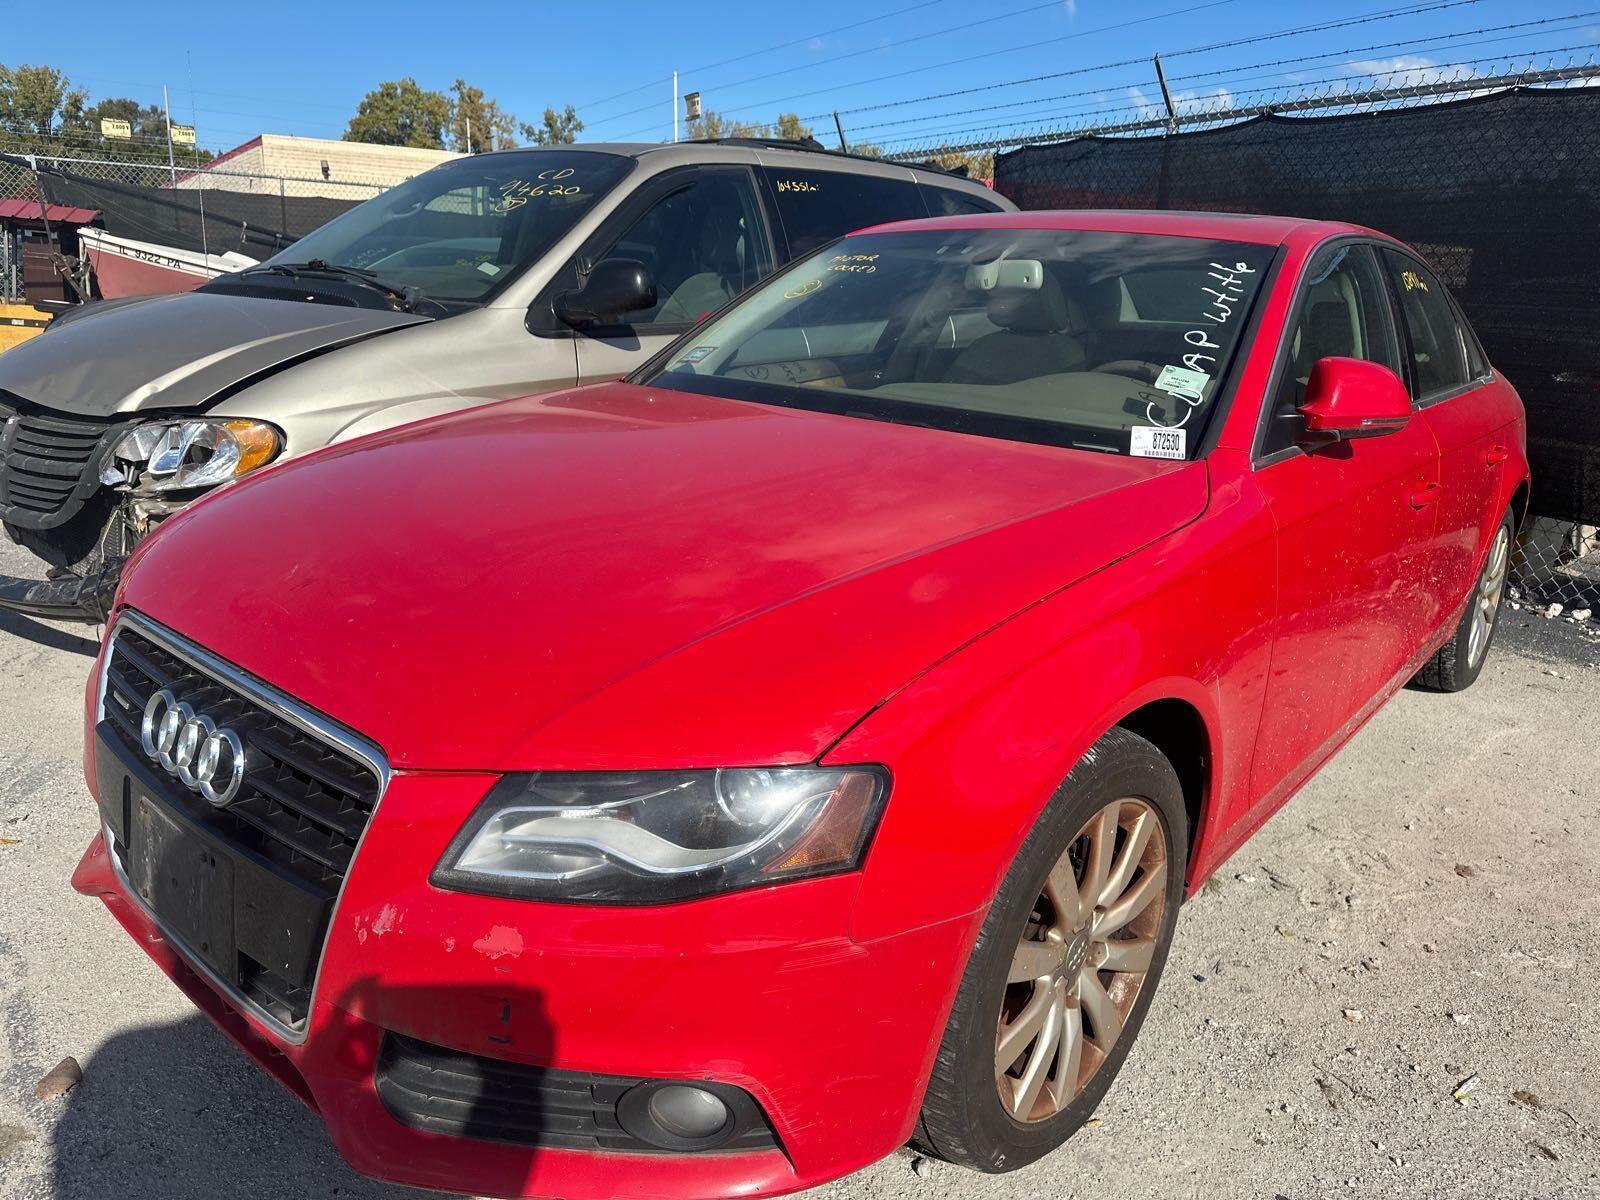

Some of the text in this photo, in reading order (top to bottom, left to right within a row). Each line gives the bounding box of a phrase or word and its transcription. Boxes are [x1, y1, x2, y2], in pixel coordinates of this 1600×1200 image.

[119, 245, 181, 269] IL 9322 PA
[1152, 432, 1180, 451] 872530
